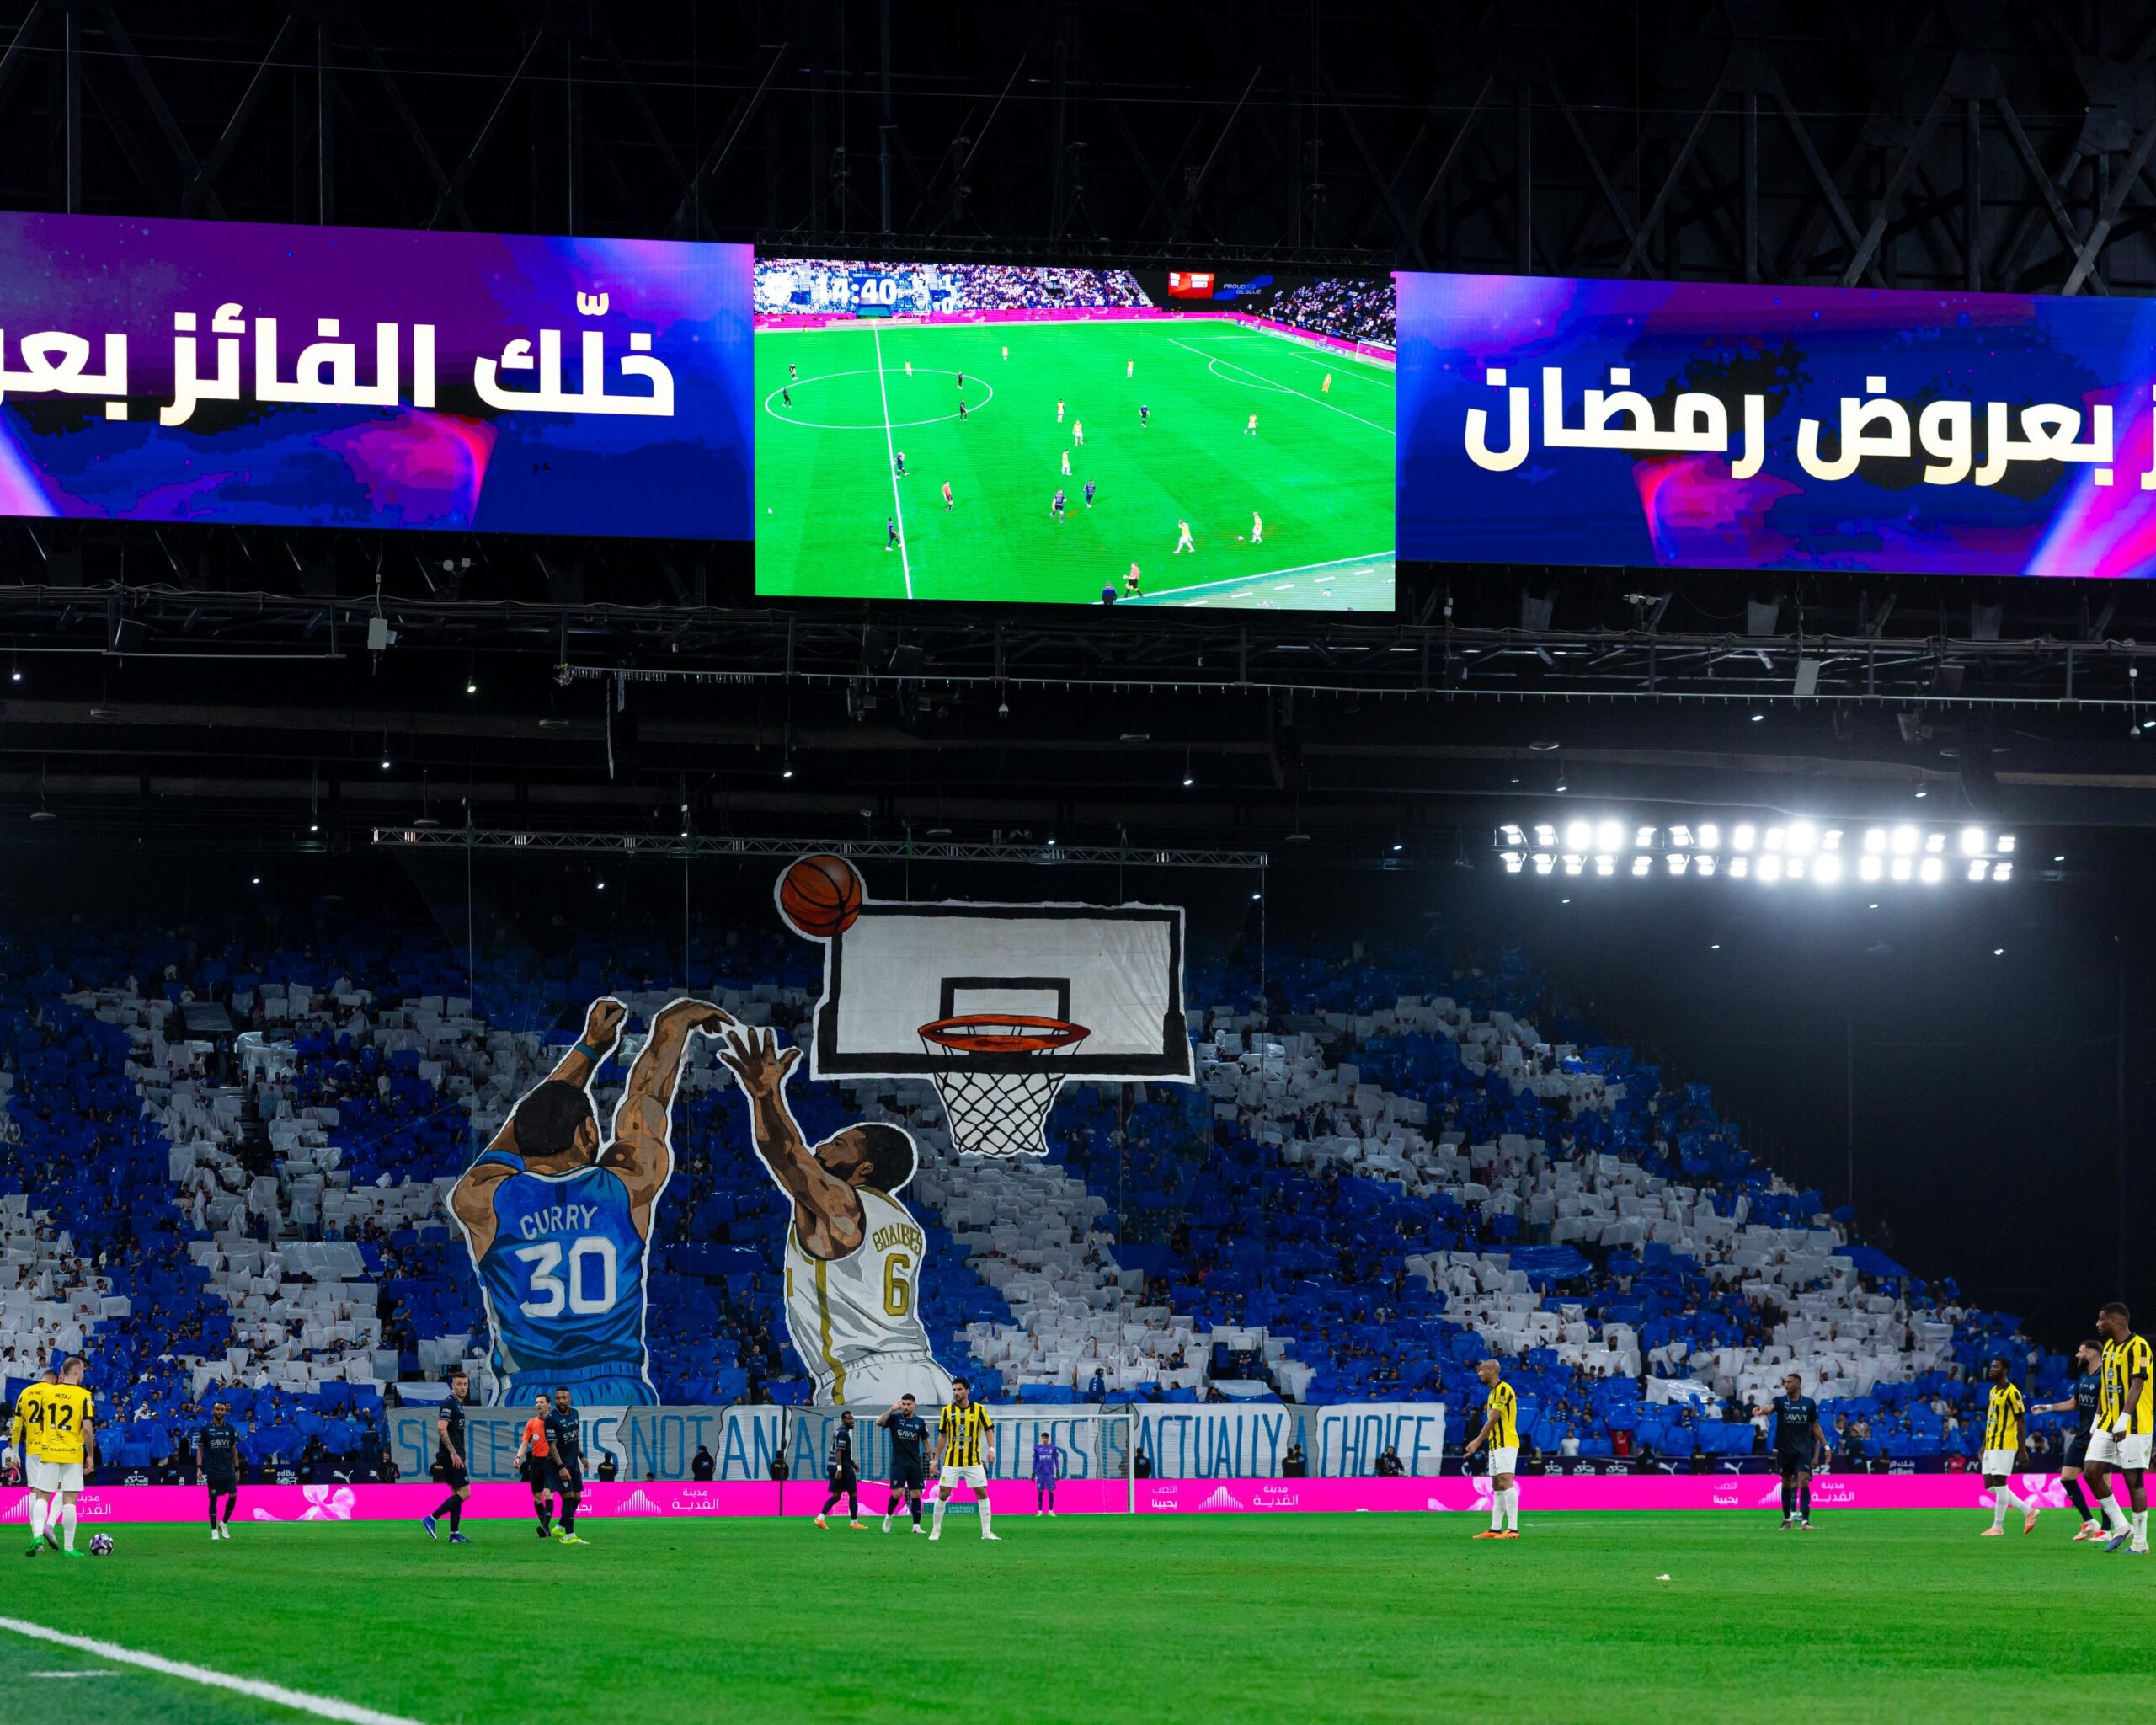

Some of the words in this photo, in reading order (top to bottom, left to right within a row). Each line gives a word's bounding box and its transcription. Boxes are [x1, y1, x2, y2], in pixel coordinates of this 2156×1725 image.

[814, 278, 897, 305] 14:40
[160, 302, 436, 427] الفائز
[1464, 366, 1765, 479] رمضان
[1796, 375, 2115, 487] بعروض
[520, 1204, 599, 1241] CURRY
[515, 1236, 617, 1318] 30
[883, 1252, 910, 1317] 6
[48, 1403, 73, 1431] 12
[582, 1417, 619, 1479] IS
[632, 1415, 714, 1480] NOT
[721, 1415, 778, 1480] AN
[1138, 1413, 1283, 1479] ACTUALLY
[1294, 1416, 1311, 1478] A
[1320, 1413, 1435, 1478] CHOICE
[683, 1488, 708, 1497] مدينة
[1263, 1485, 1289, 1494] مدينة
[1811, 1491, 1855, 1503] القدية
[1821, 1482, 1844, 1490] مدينة
[75, 1503, 111, 1518] القدي
[671, 1498, 719, 1511] القدية
[1253, 1494, 1299, 1508] القدية
